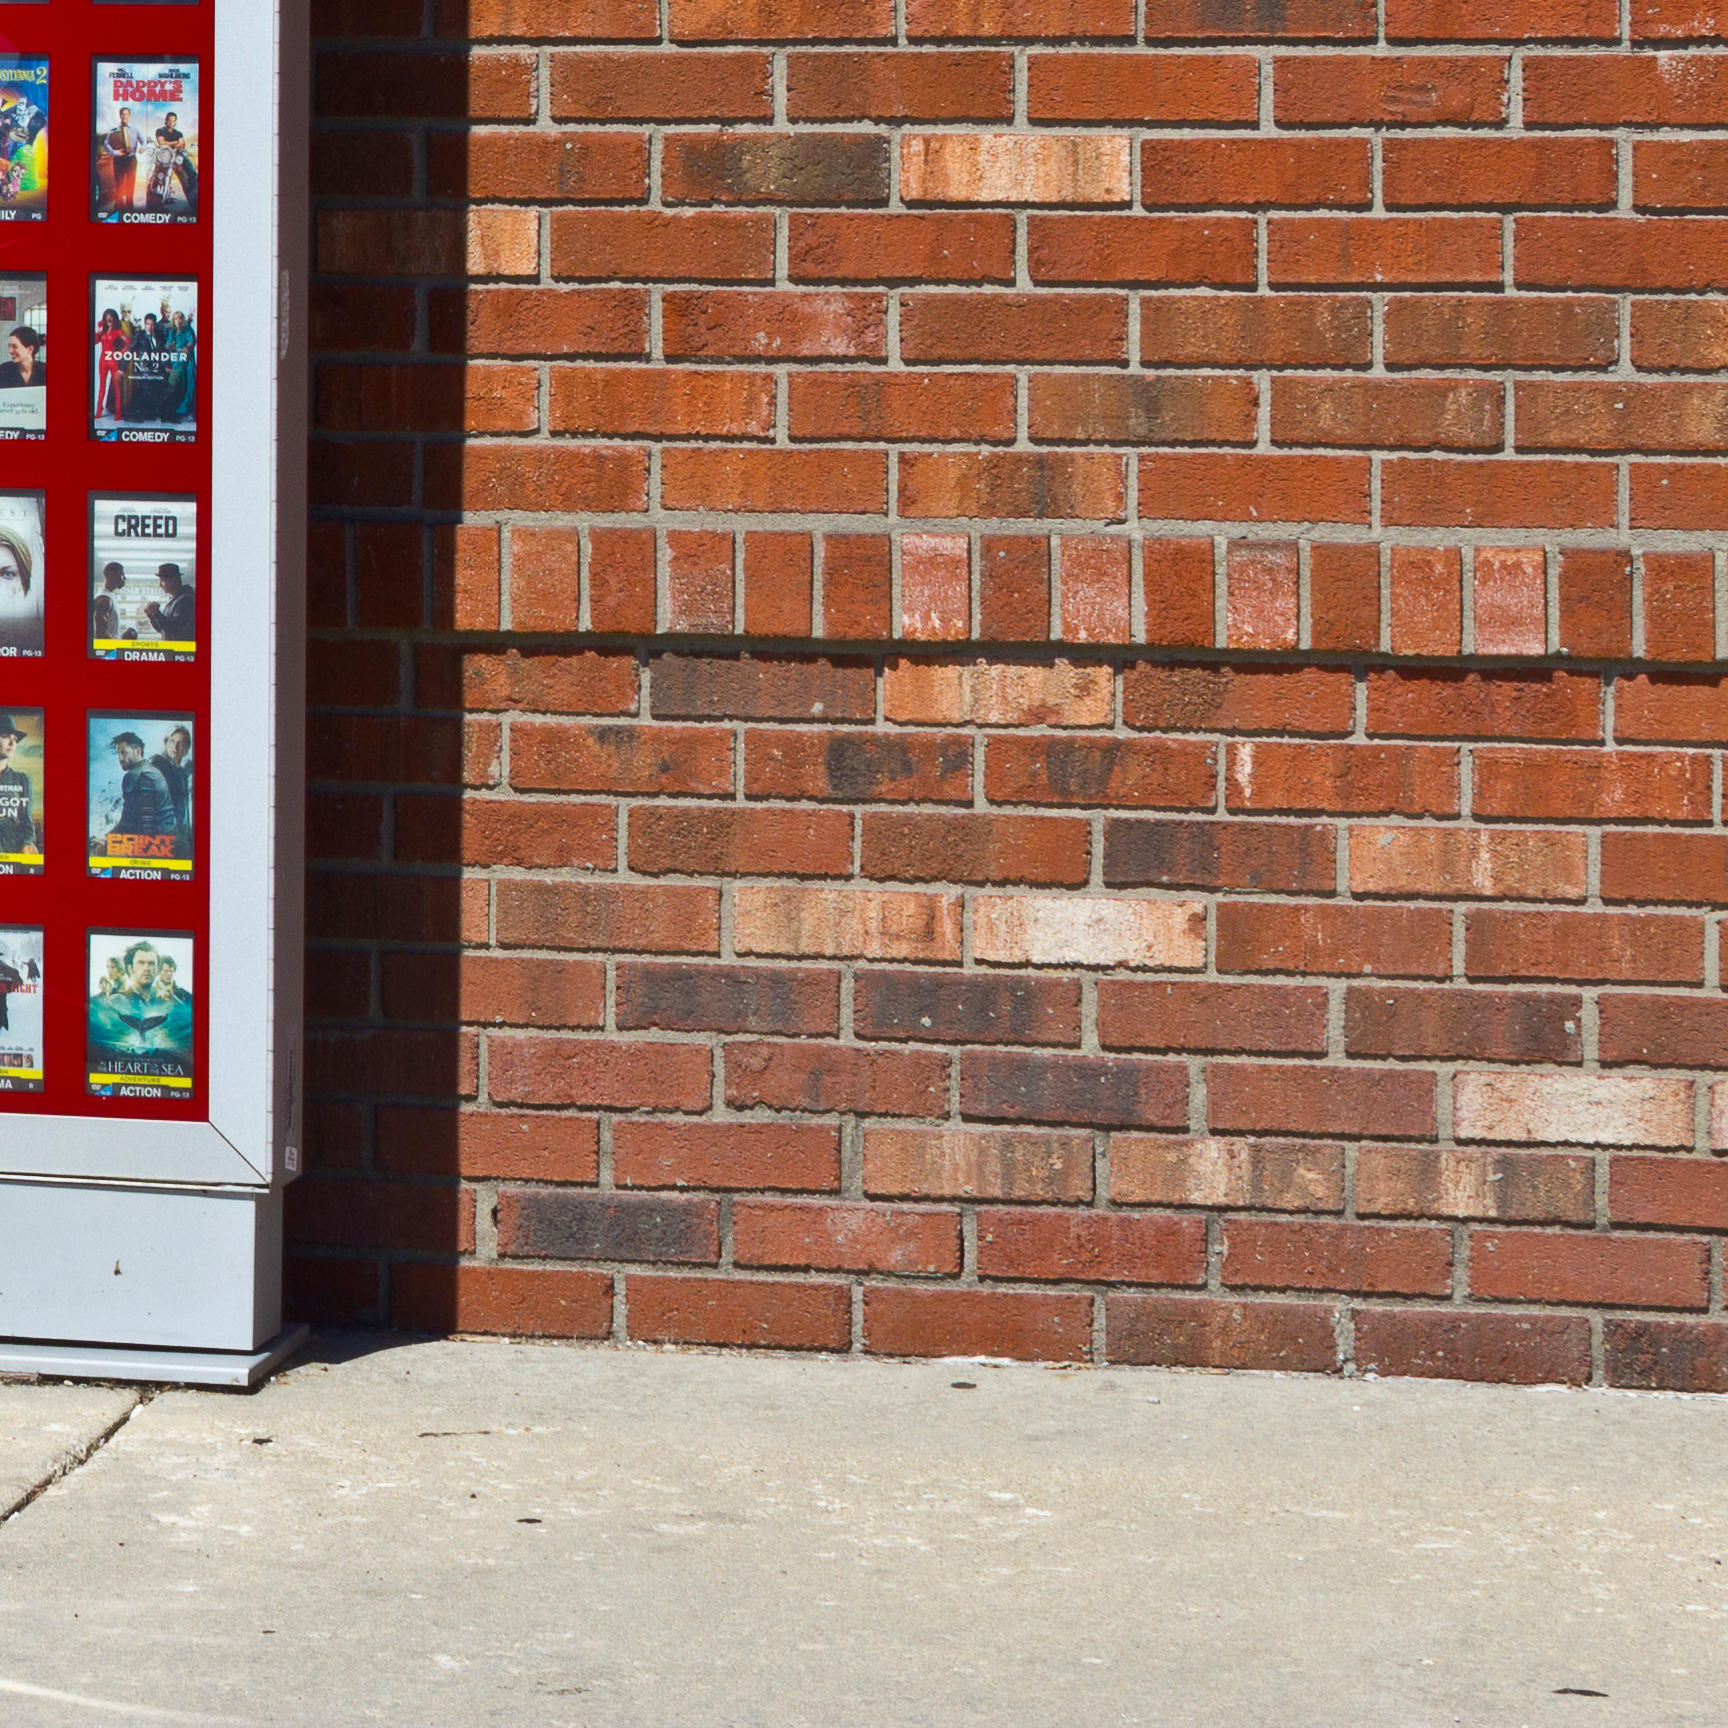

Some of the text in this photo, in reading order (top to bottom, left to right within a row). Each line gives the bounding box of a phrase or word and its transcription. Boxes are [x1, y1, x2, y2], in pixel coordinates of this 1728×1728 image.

[113, 89, 182, 102] HOME
[105, 351, 187, 361] ZOOLANDER
[134, 362, 159, 372] No. 2
[115, 515, 177, 537] CREED
[124, 651, 165, 662] DRAMA
[107, 834, 176, 845] POINT
[107, 845, 174, 856] BREAK
[120, 869, 161, 880] ACTION
[108, 1061, 183, 1075] HEART SEA
